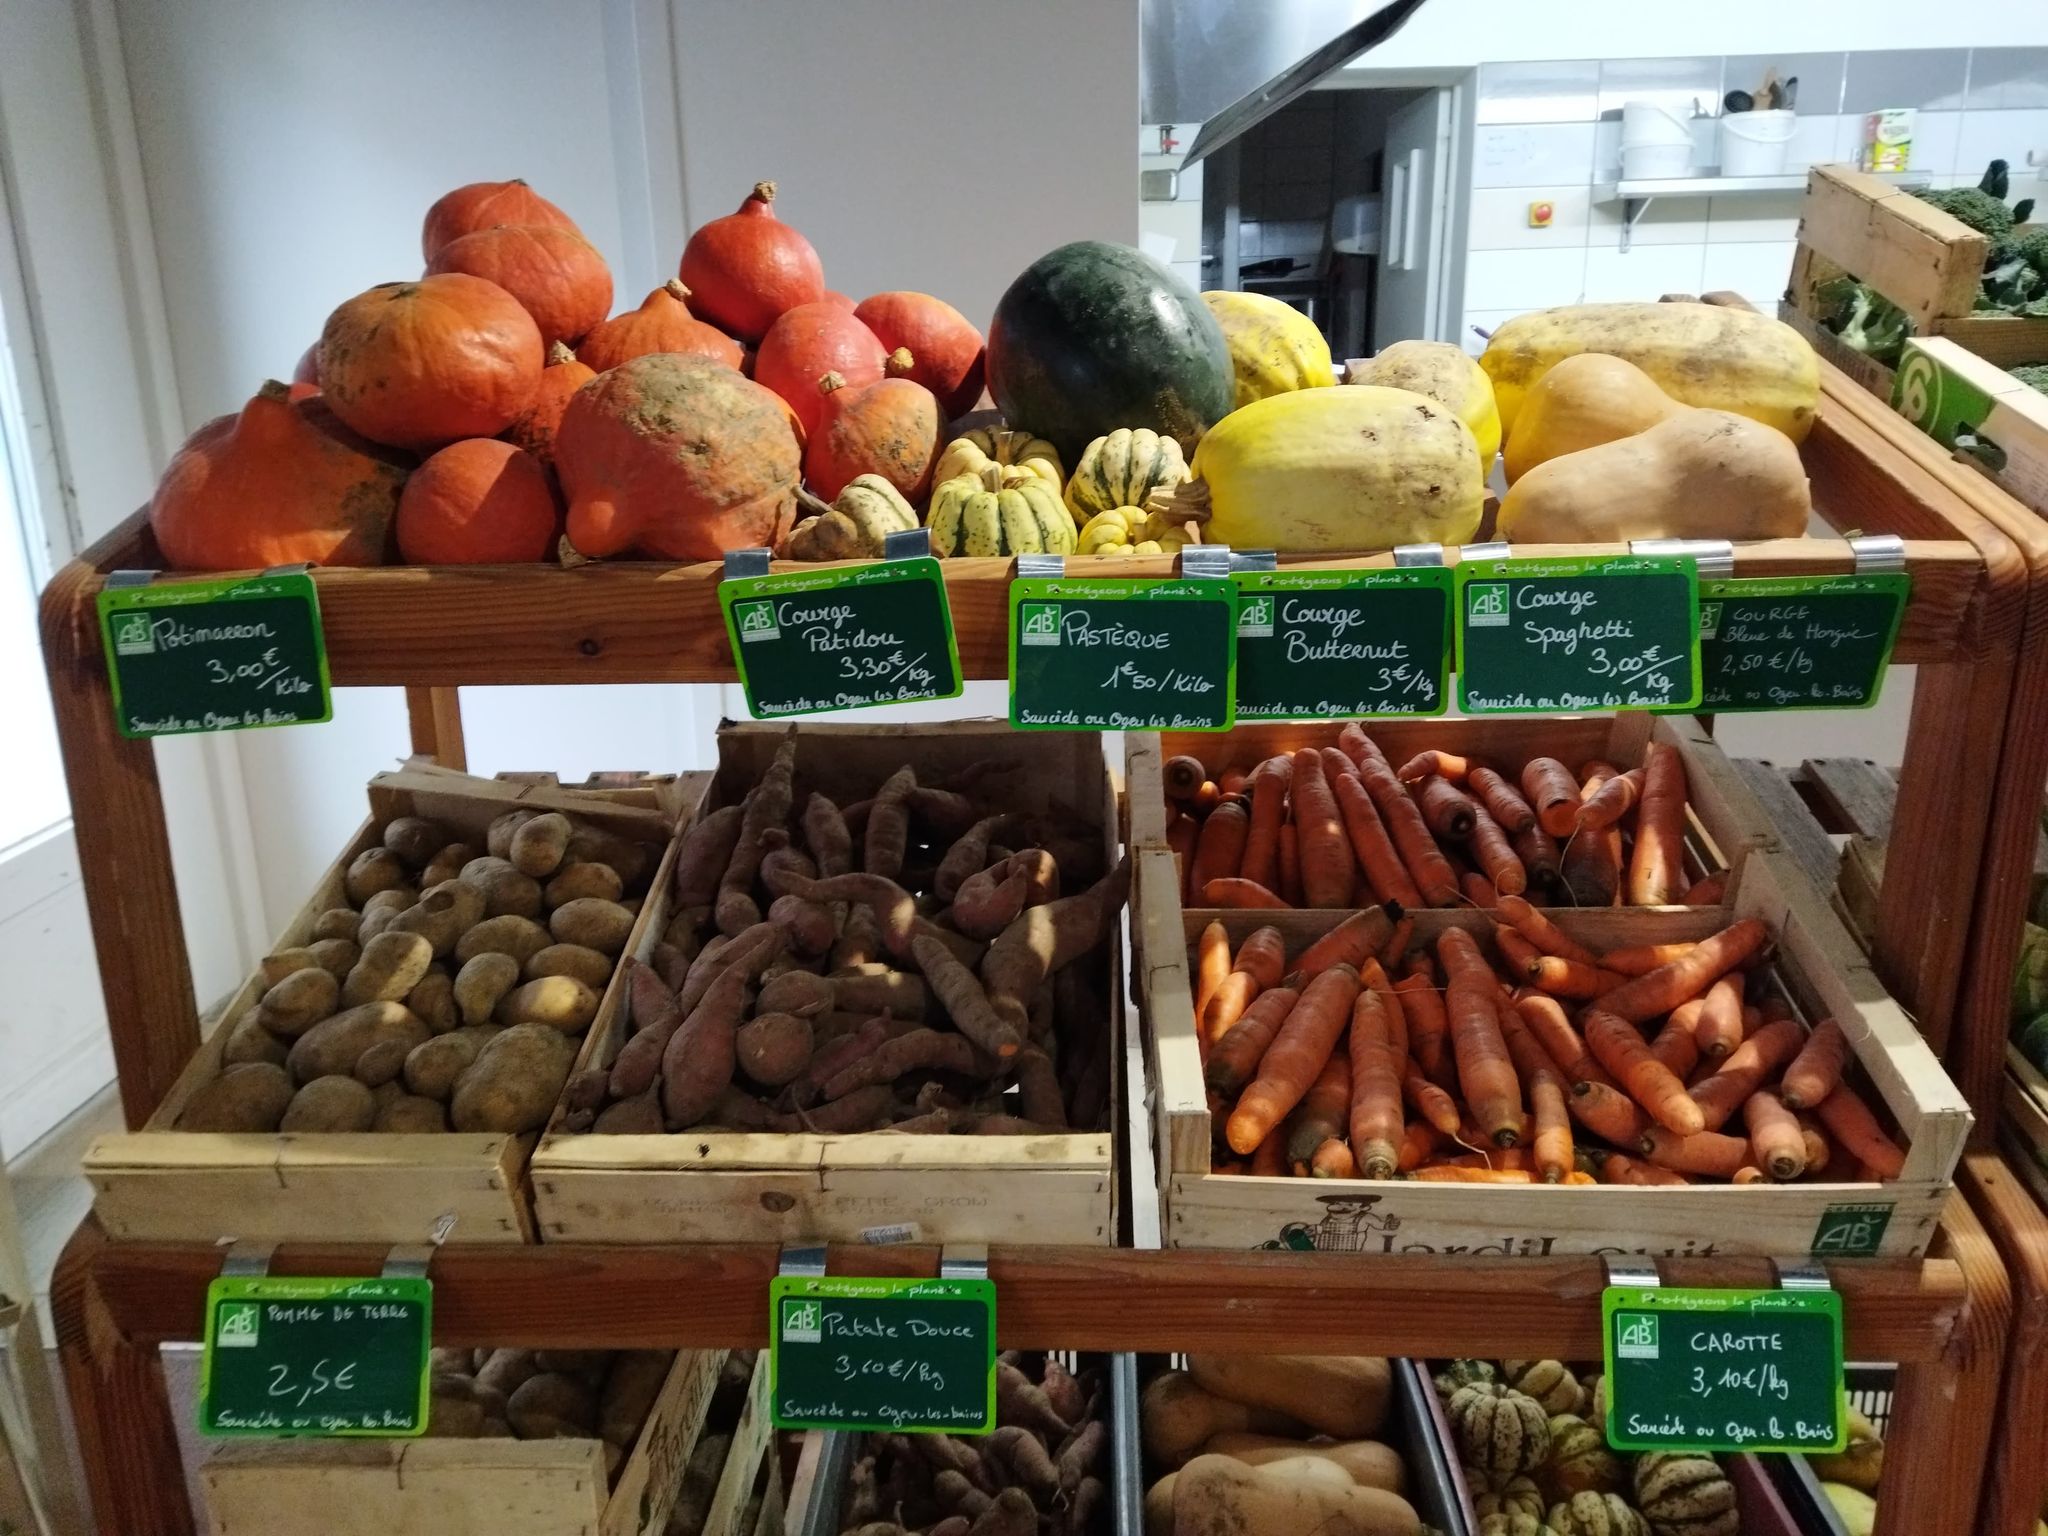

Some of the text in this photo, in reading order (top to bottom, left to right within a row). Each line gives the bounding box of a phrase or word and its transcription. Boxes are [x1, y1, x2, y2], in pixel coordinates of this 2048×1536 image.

[1473, 593, 1502, 614] AB
[1516, 584, 1598, 615] Courge
[743, 610, 771, 631] AB
[778, 602, 856, 629] Courge
[1025, 612, 1055, 633] AB
[1239, 605, 1268, 625] AB
[1282, 599, 1366, 638] Courge
[1701, 611, 1713, 629] B
[119, 622, 147, 643] AB
[152, 618, 276, 651] Potimarron
[802, 626, 904, 652] Patidou
[1524, 620, 1634, 655] Spaghetti
[1777, 624, 1794, 640] de
[1283, 629, 1409, 663] Butternut
[1815, 1222, 1871, 1249] AB
[222, 1311, 252, 1334] AB
[787, 1309, 815, 1330] AB
[821, 1312, 899, 1338] Patate
[905, 1318, 974, 1338] Douce
[1622, 1324, 1652, 1345] AB
[267, 1358, 357, 1407] 2,5€
